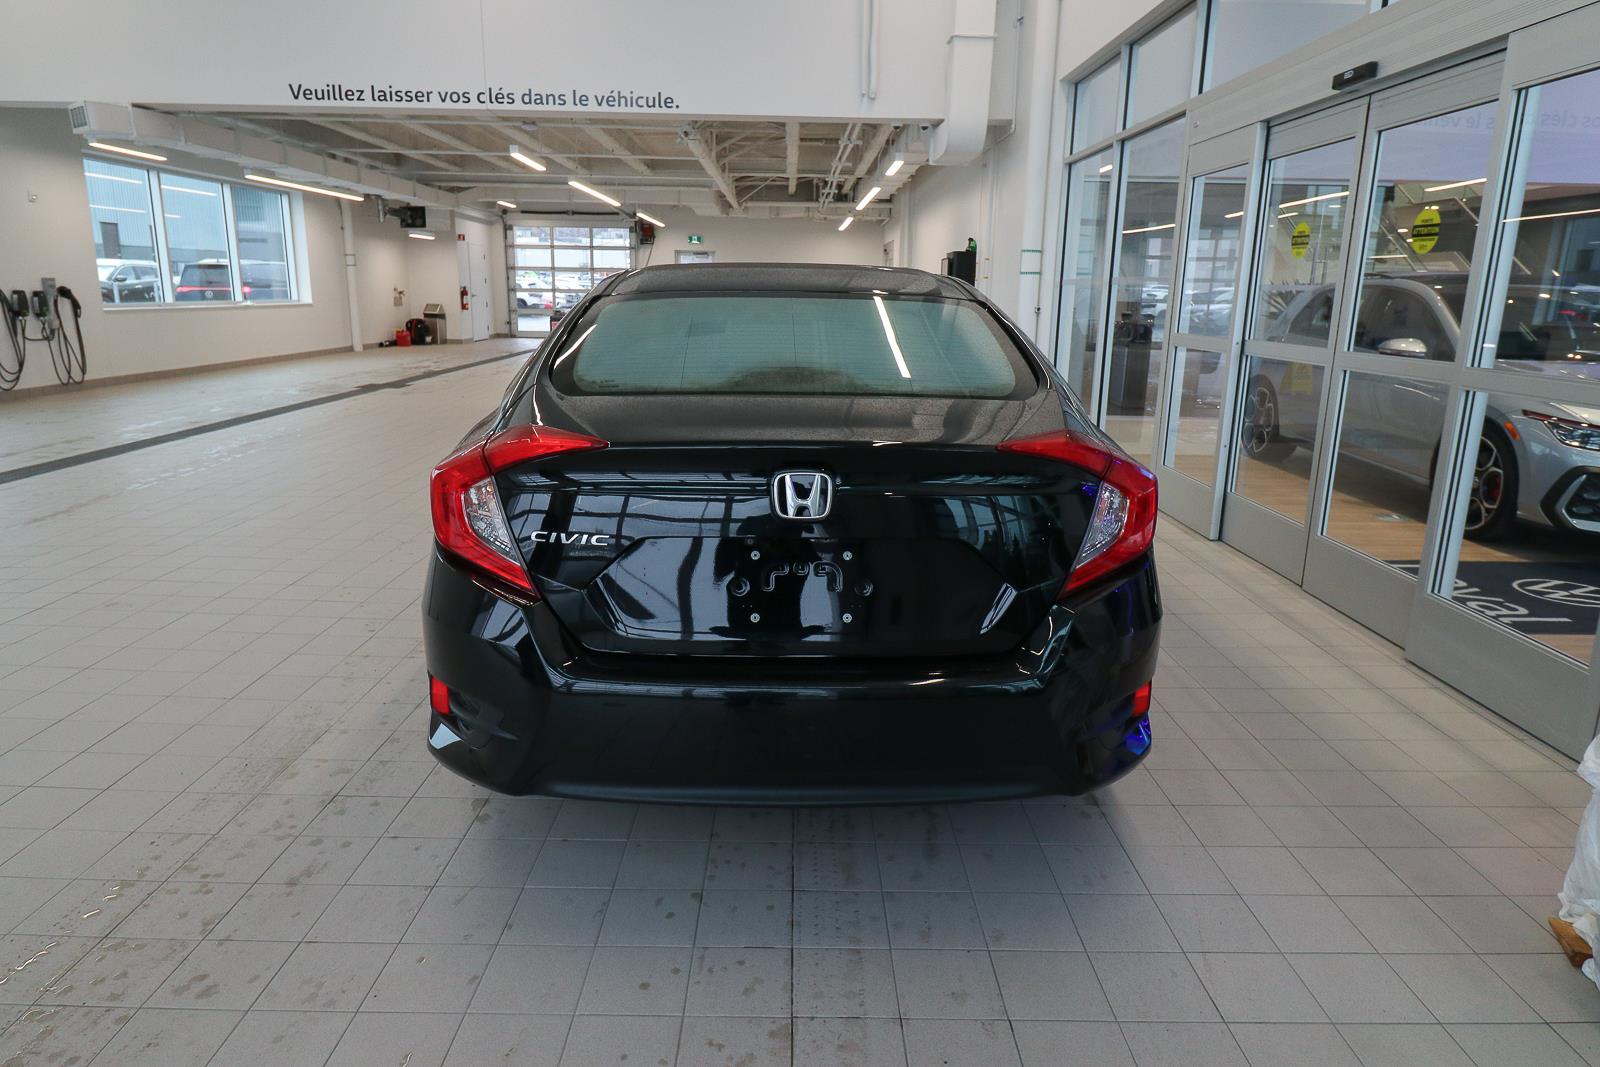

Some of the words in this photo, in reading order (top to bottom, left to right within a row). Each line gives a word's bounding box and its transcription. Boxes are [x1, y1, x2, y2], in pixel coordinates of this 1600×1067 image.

[288, 83, 365, 102] Veuillez
[370, 85, 433, 103] laisser
[437, 90, 471, 104] vos
[476, 87, 515, 105] clés
[521, 88, 567, 106] dans
[572, 89, 589, 107] le
[594, 90, 680, 109] véhicule.
[530, 531, 610, 546] CIVIC
